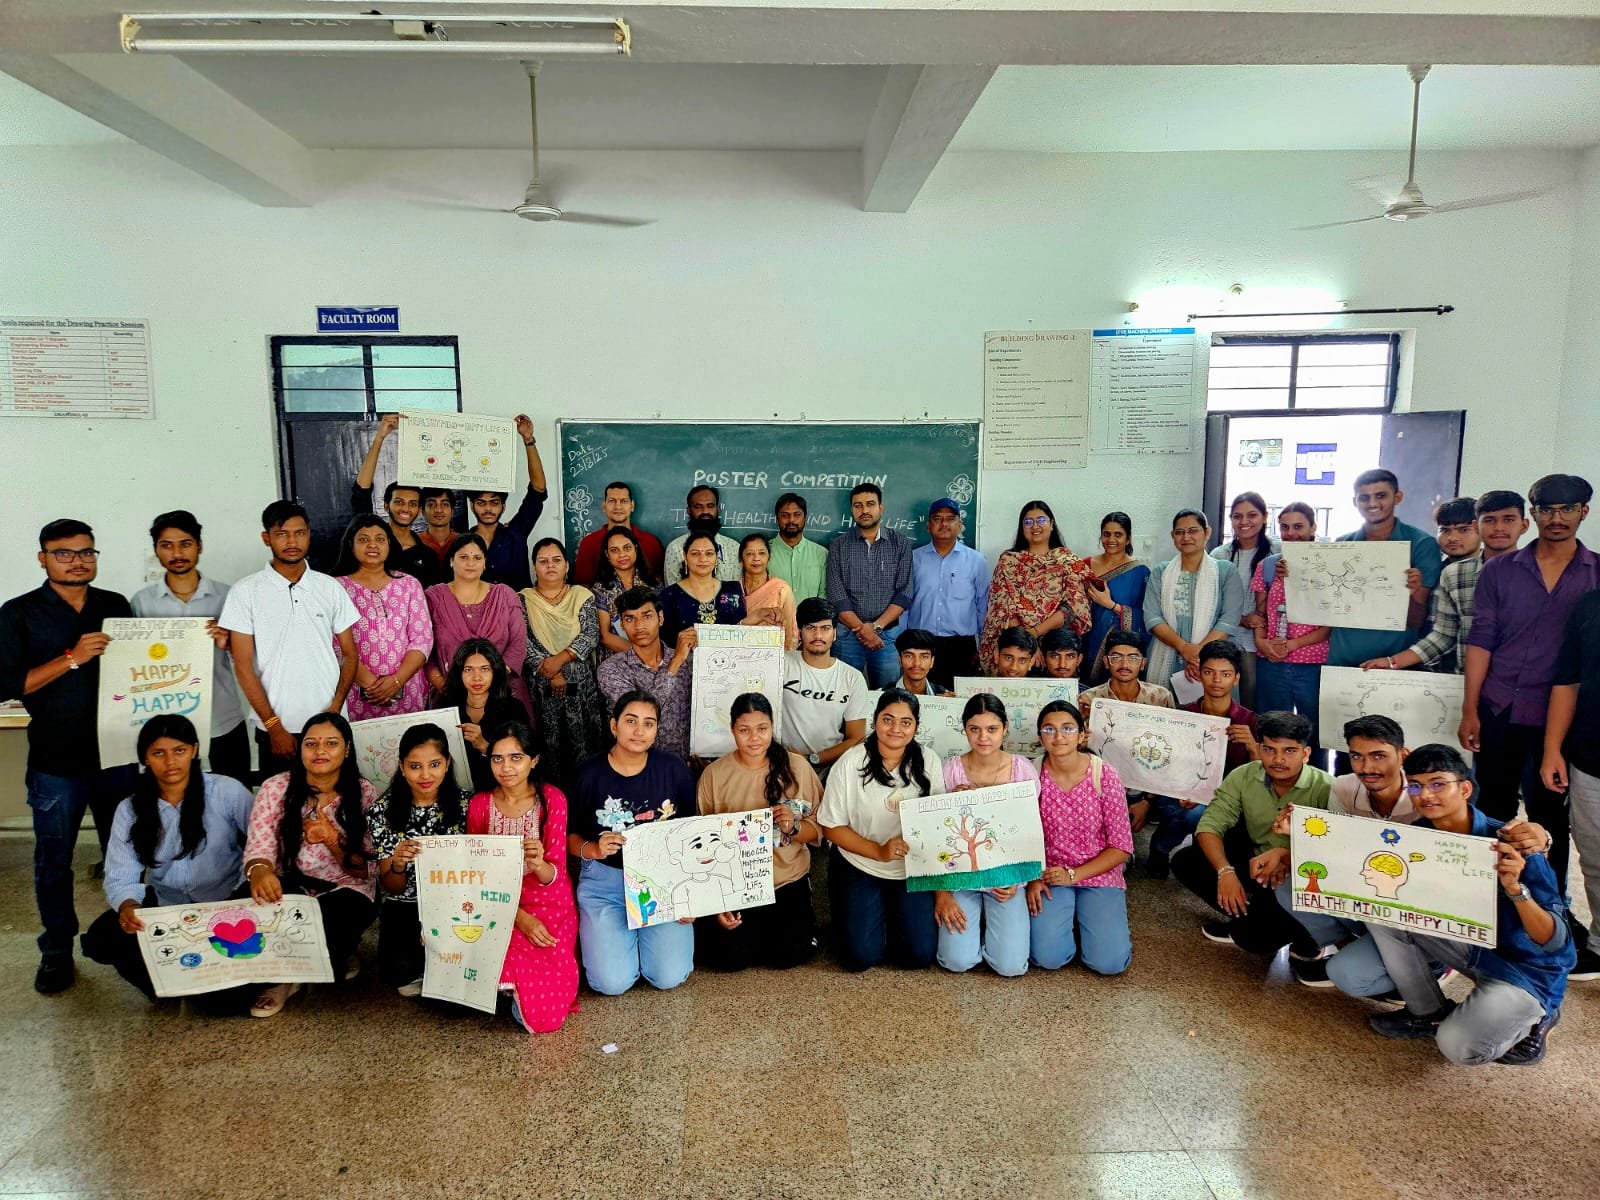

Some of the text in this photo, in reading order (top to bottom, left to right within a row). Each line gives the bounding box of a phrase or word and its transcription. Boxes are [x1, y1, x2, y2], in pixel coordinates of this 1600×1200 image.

[321, 314, 395, 324] FACULTY ROOM
[1035, 334, 1068, 342] DRAWING
[568, 444, 594, 462] Date
[569, 446, 608, 478] 23/8/25
[693, 469, 888, 489] POSTER COMPETITION
[112, 619, 169, 631] HEALTHY
[111, 630, 185, 641] HAPPY LIFE
[130, 663, 191, 683] HAPPY
[1000, 686, 1044, 699] BODY
[131, 691, 201, 714] HAPPY
[421, 839, 484, 849] HEALTHY MIND
[1434, 840, 1468, 850] HAPPY
[470, 848, 489, 857] HAPPY
[429, 869, 487, 886] HAPPY
[1462, 868, 1494, 881] LIFE
[480, 890, 511, 904] MIND
[1296, 892, 1488, 941] HEALTHY MIND HAPPY LIFE
[438, 951, 465, 966] HAPPY
[463, 967, 478, 982] LIFE
